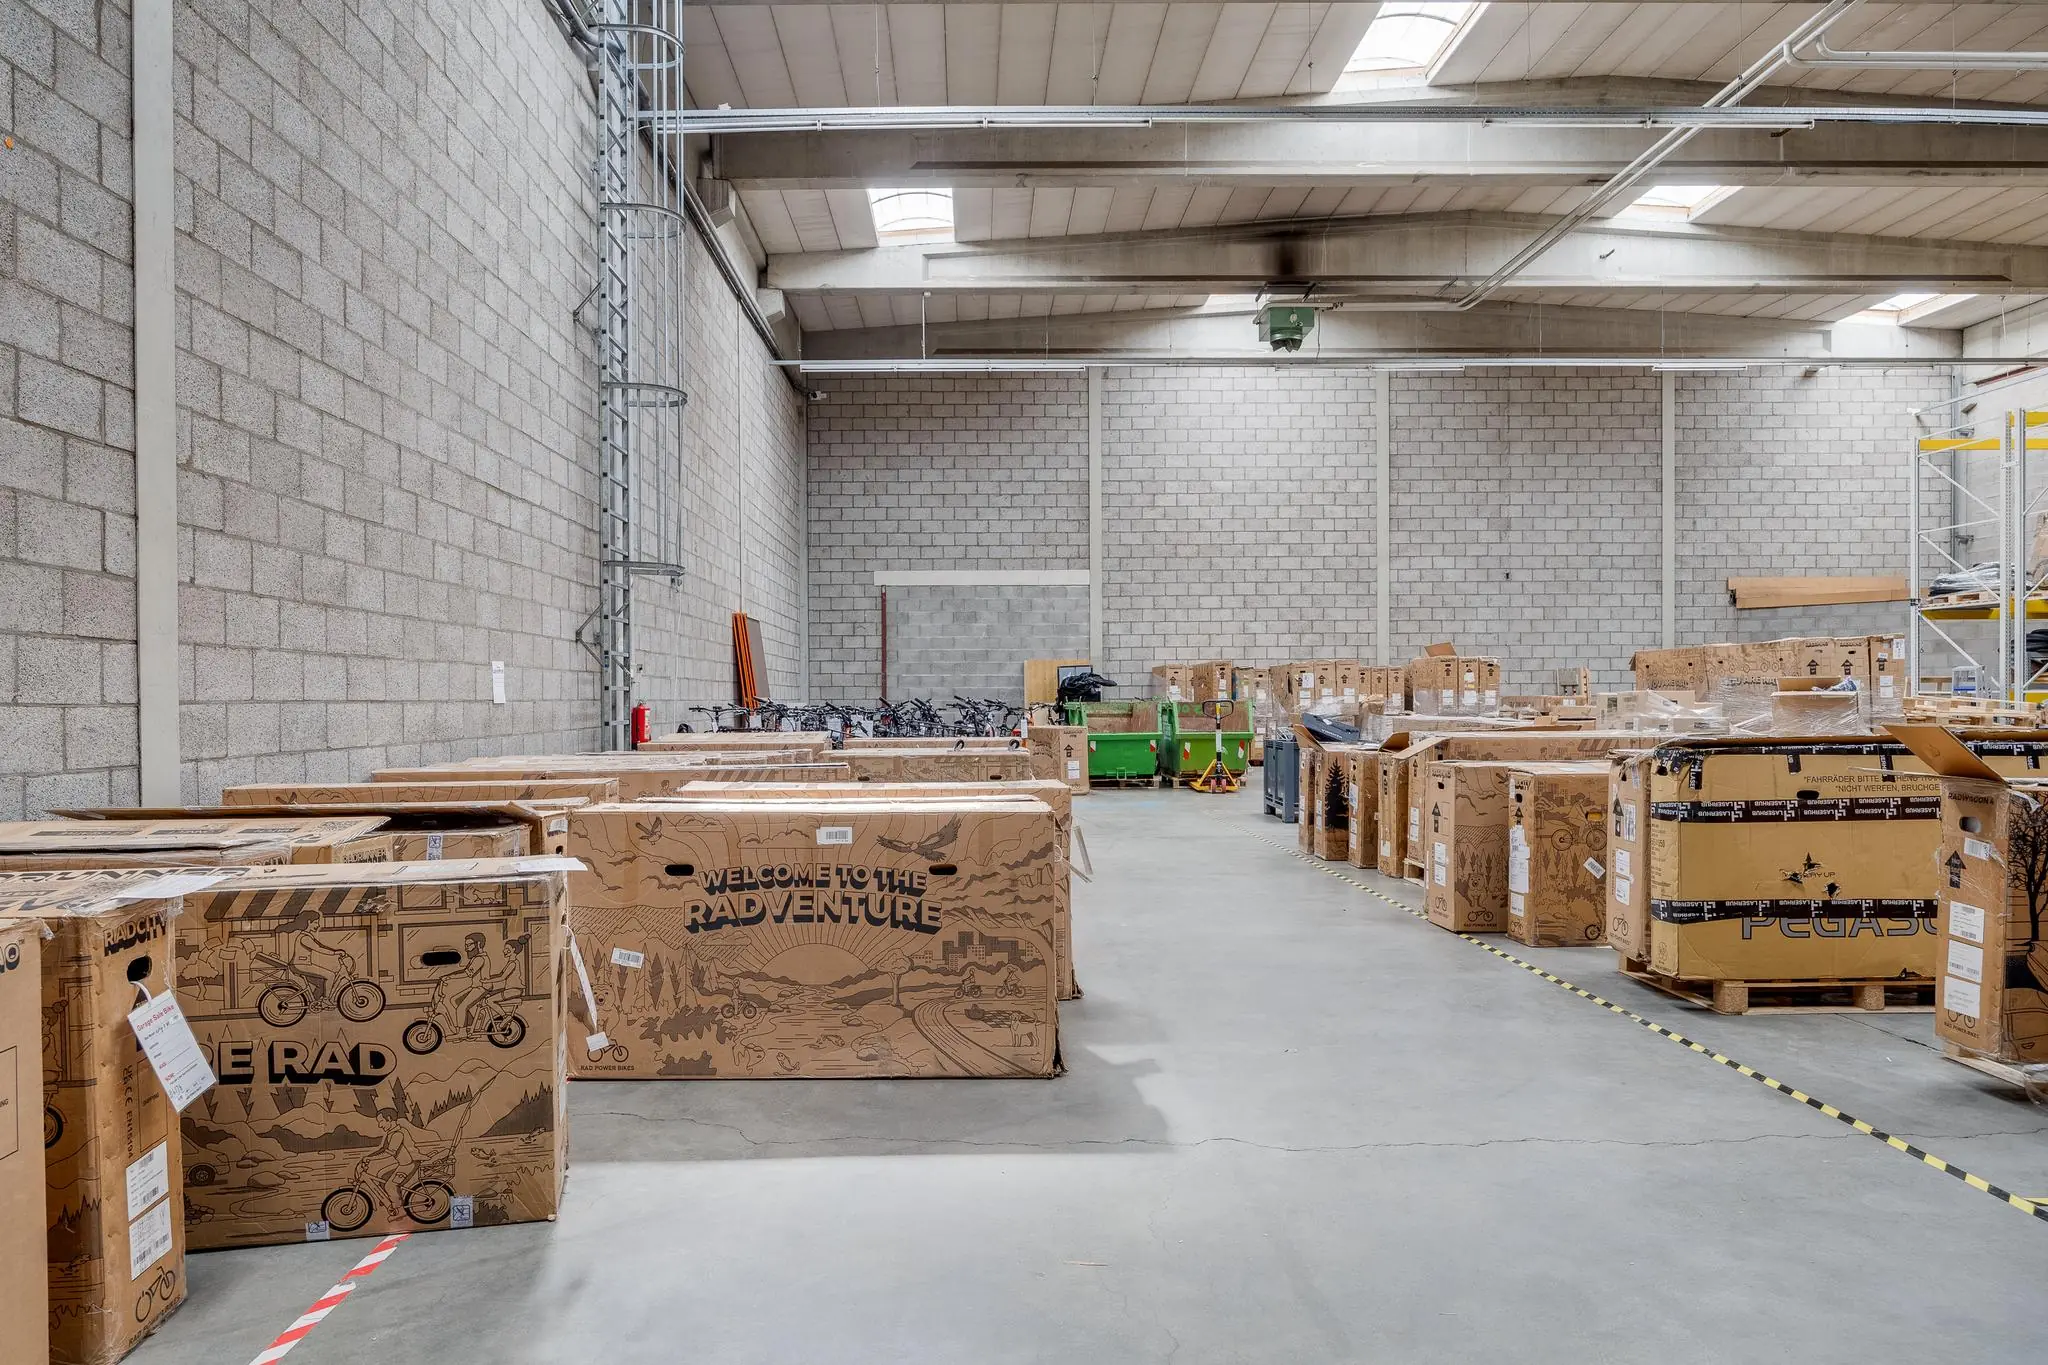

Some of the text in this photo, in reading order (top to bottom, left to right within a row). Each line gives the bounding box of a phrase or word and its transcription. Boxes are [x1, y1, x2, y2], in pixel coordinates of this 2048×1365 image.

[1864, 784, 1900, 792] WERFEN,
[698, 863, 928, 897] WELCOME TO THE
[104, 908, 168, 957] RADCITY
[683, 890, 943, 935] RADVENTURE
[268, 1040, 398, 1086] RAD
